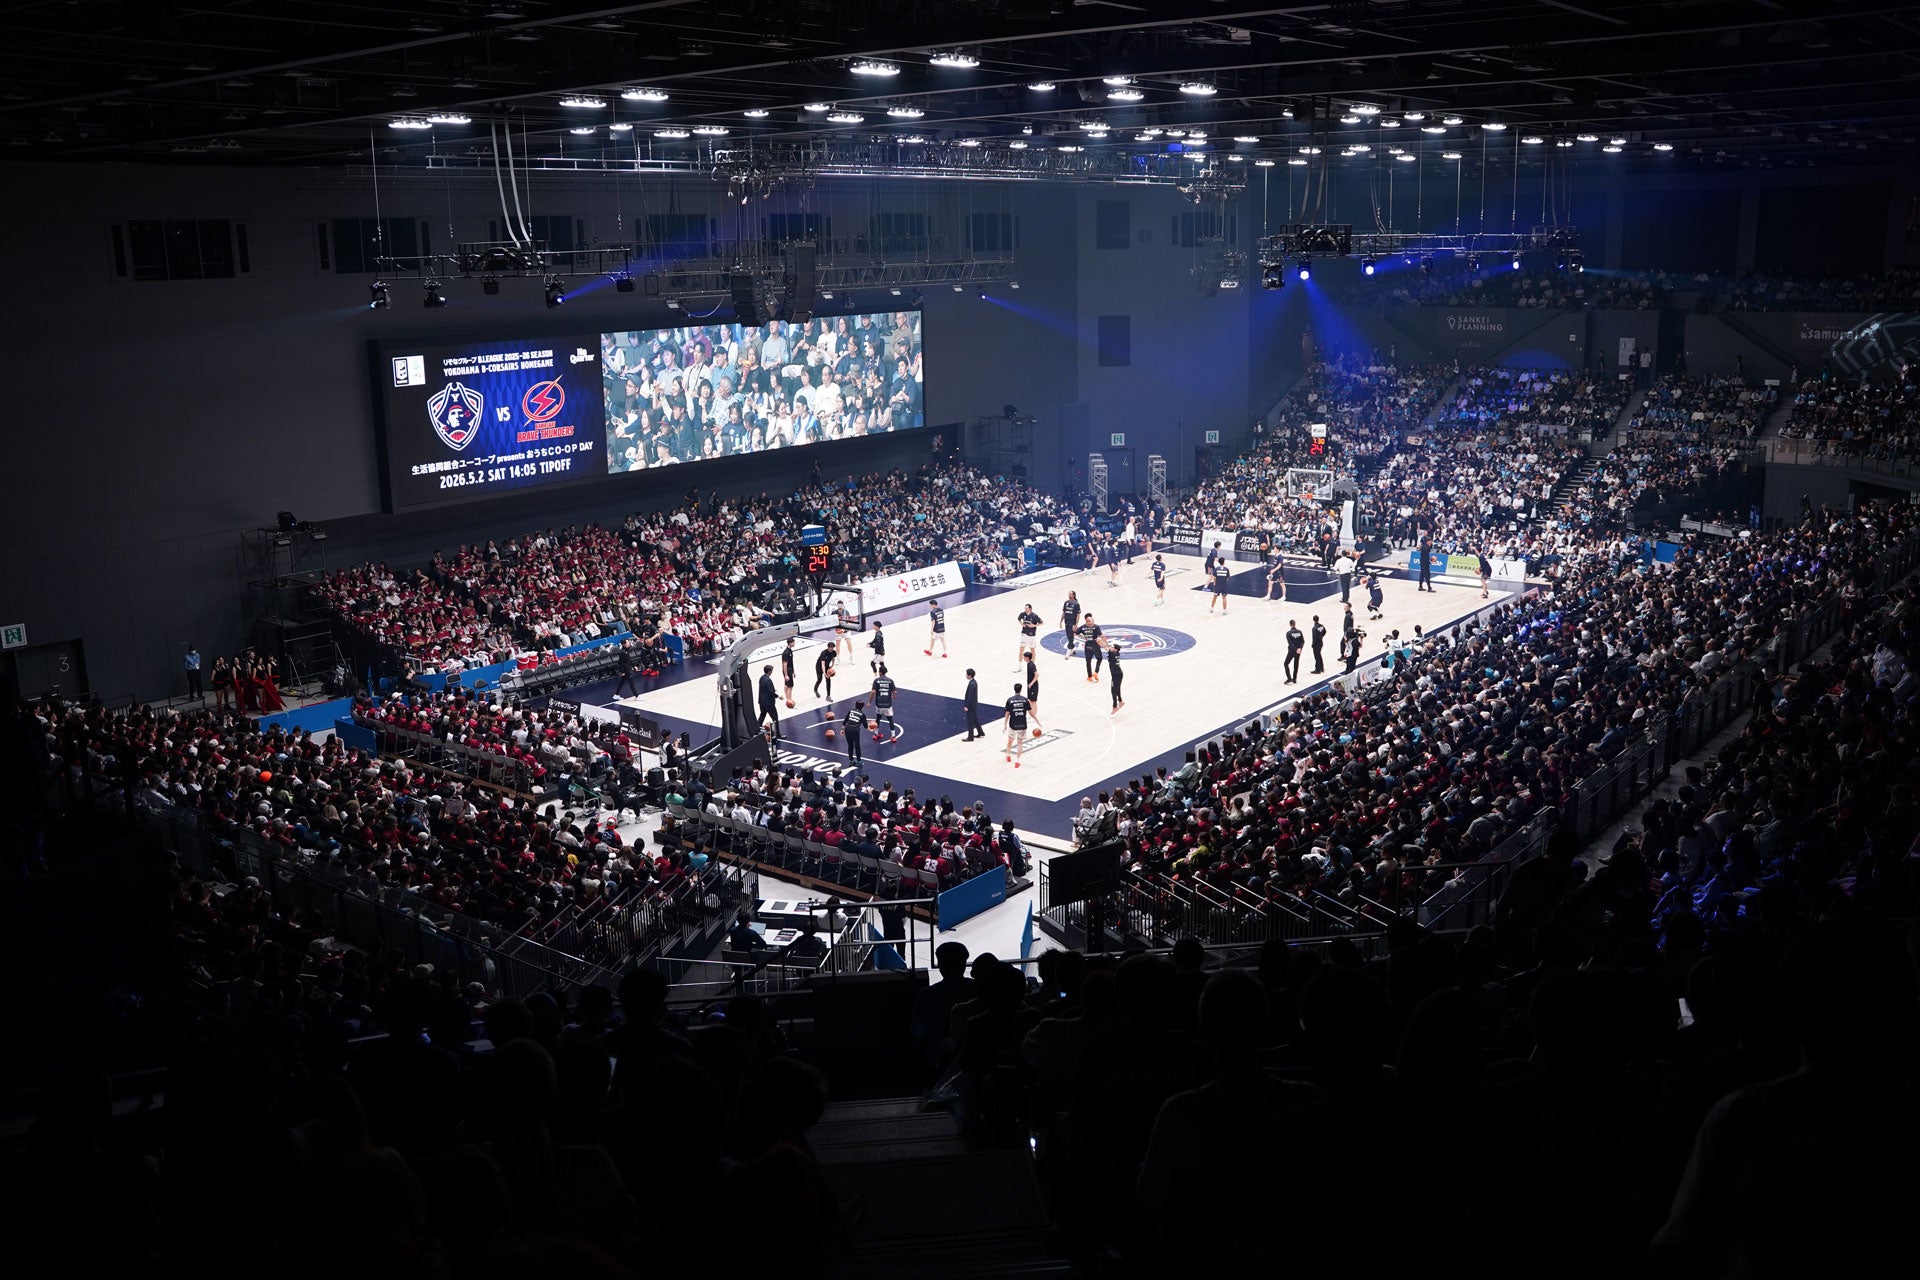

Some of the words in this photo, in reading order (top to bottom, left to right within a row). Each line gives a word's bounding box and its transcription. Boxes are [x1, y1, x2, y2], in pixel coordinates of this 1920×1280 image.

[1457, 316, 1490, 324] SANKEI
[1457, 323, 1504, 332] PLANNING
[530, 349, 554, 359] SEASON
[443, 365, 480, 377] YOKOHAMA
[481, 361, 519, 373] B-CORSAIRS
[520, 358, 554, 370] HOMEGAME
[496, 406, 511, 422] VS
[517, 430, 539, 443] BRAVE
[540, 425, 574, 440] THUNDERS
[411, 454, 496, 476] 生活協同組合ユーコープ
[496, 452, 526, 465] presents
[578, 440, 594, 452] DAY
[439, 469, 485, 489] 2026.5.2
[488, 467, 506, 482] SAT
[509, 463, 537, 479] 14:05
[539, 458, 571, 474] TIPOFF
[1172, 535, 1200, 545] B.LEAGUE
[810, 545, 830, 556] 7:30
[808, 556, 827, 572] 24
[911, 573, 946, 592] 日本生命
[58, 656, 70, 673] 3
